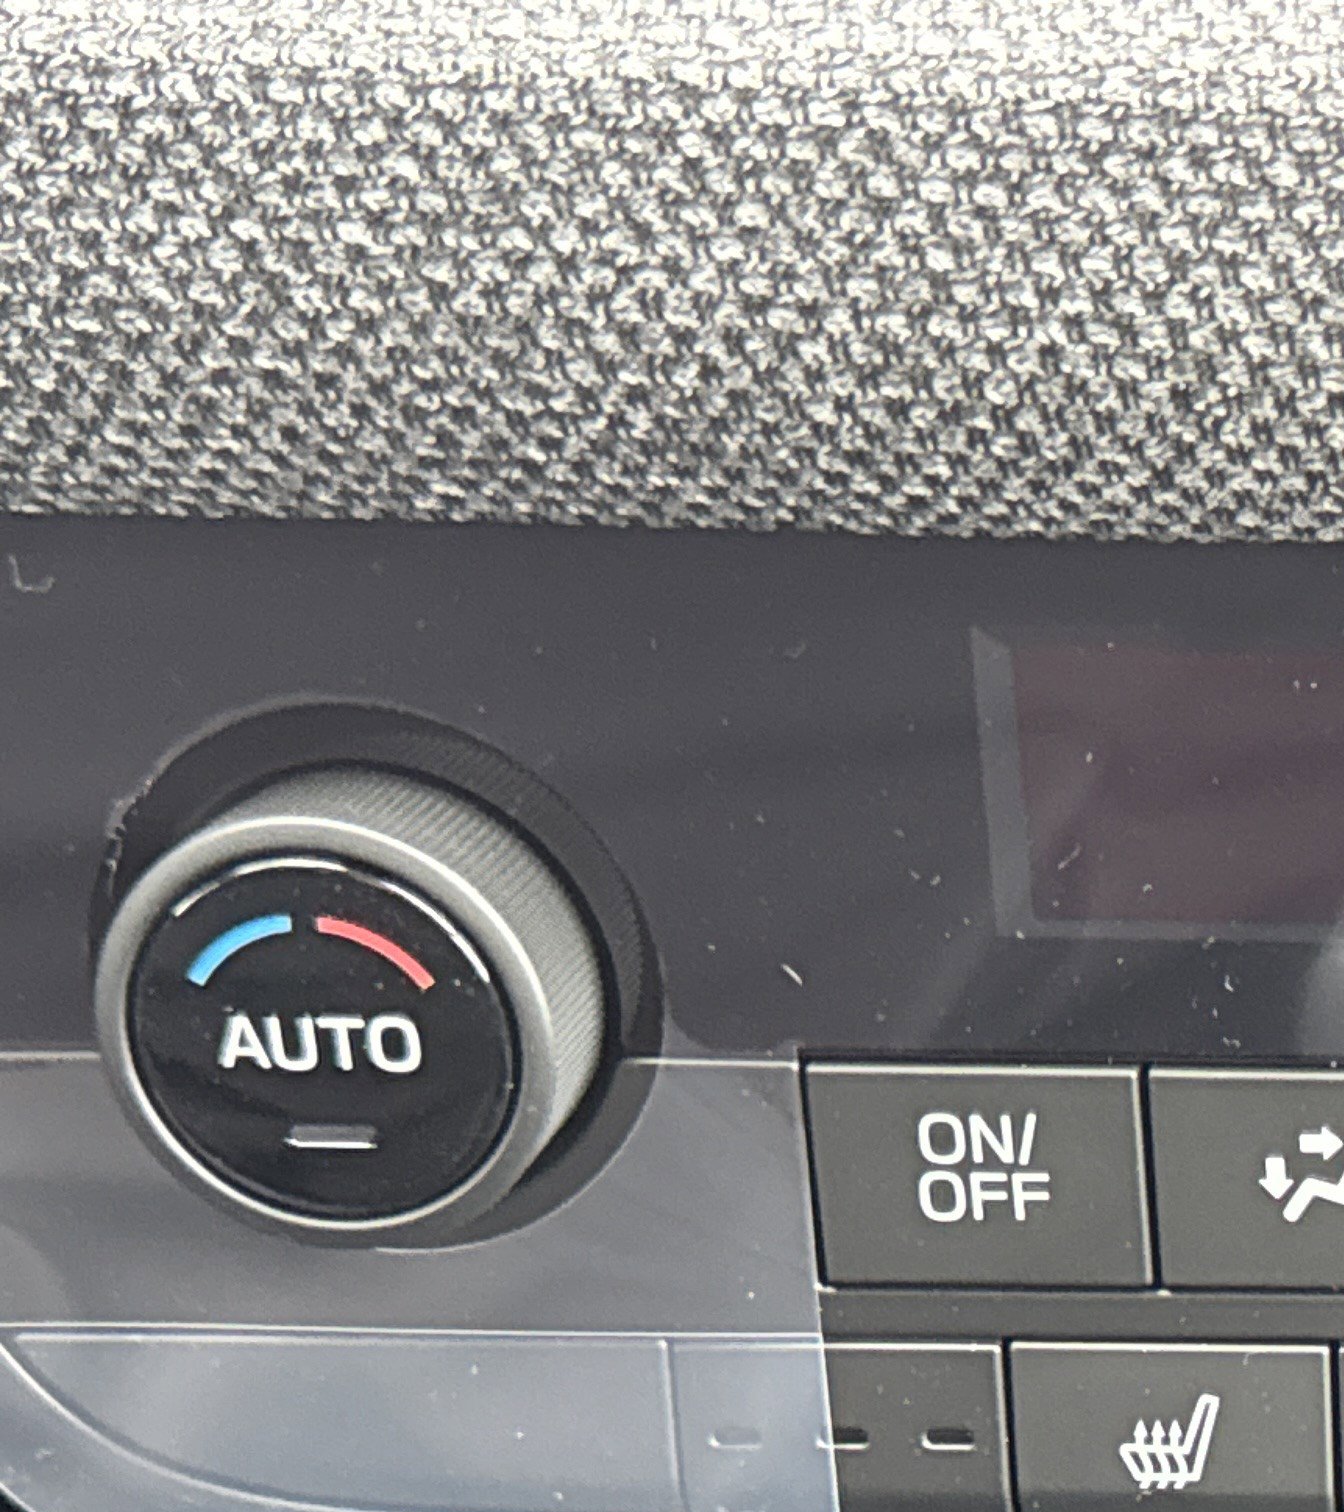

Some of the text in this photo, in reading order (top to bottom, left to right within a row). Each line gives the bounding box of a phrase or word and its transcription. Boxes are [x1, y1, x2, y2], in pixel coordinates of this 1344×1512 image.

[218, 1012, 423, 1074] AUTO
[917, 1111, 1038, 1167] ON/
[917, 1170, 1052, 1224] OFF
